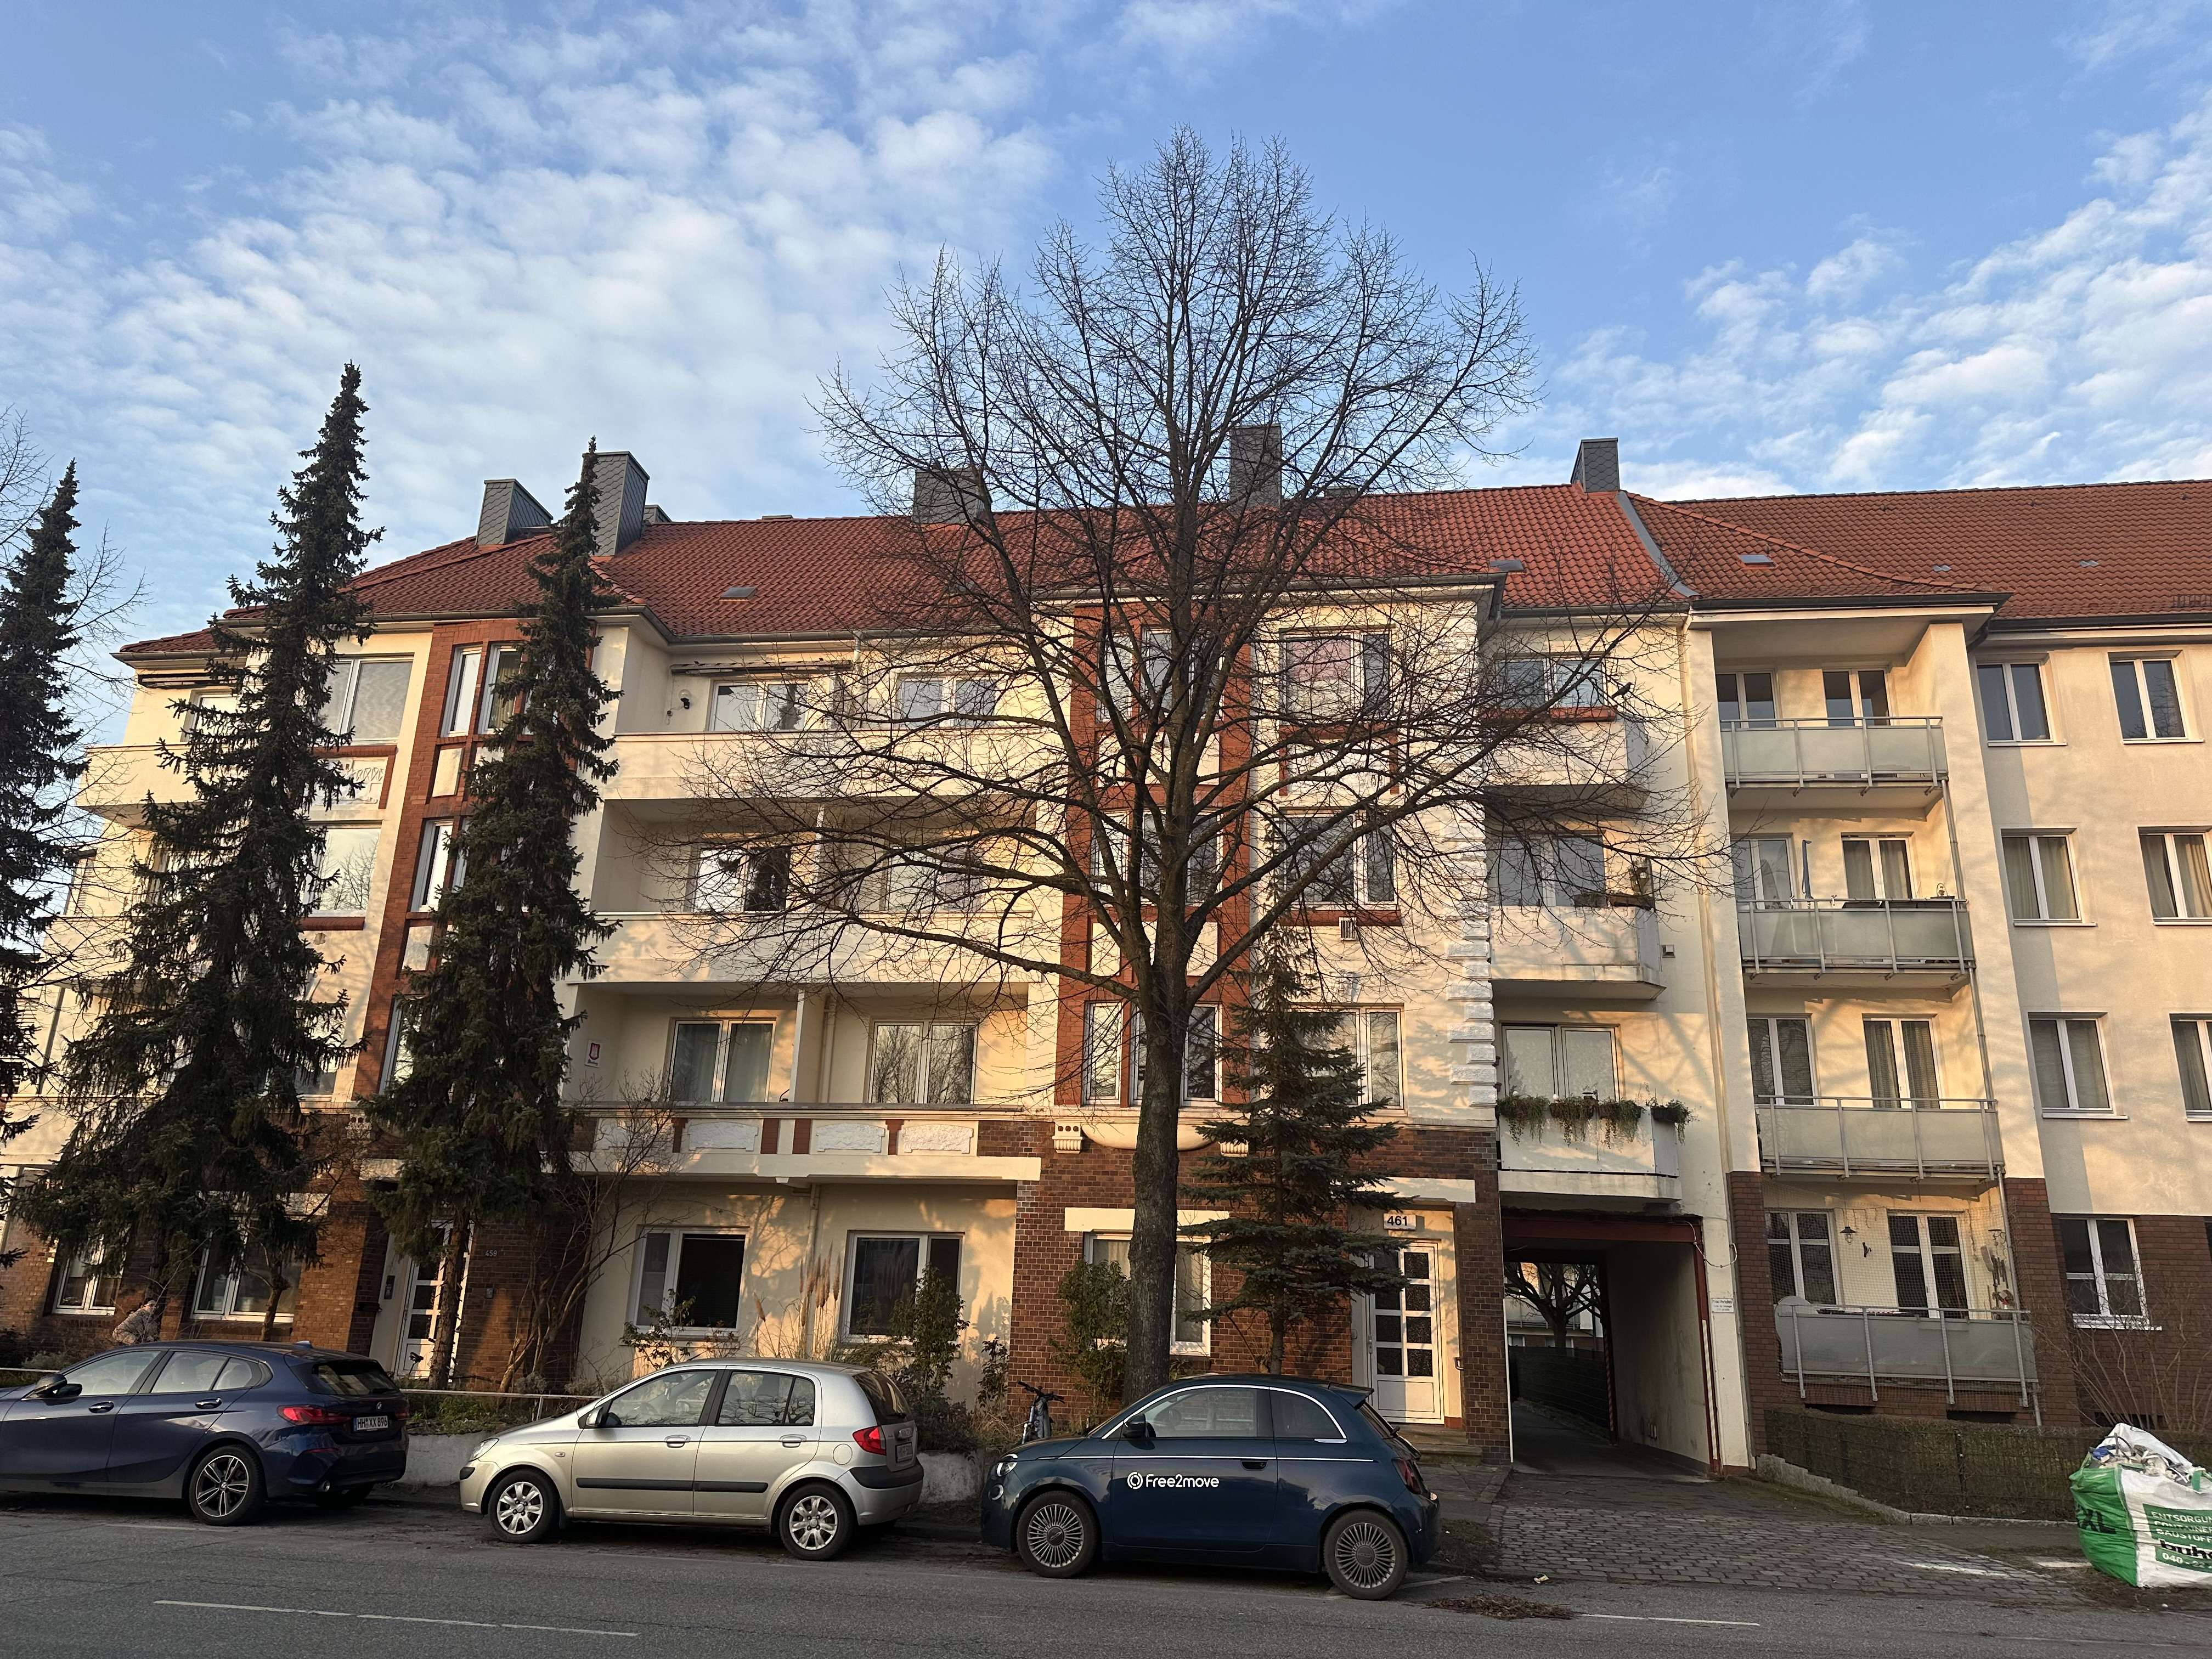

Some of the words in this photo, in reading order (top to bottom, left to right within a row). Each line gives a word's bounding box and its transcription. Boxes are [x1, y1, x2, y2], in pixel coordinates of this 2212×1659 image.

[1387, 1215, 1407, 1226] 461
[357, 1418, 365, 1429] HH
[369, 1417, 376, 1427] XX
[377, 1417, 387, 1427] 896
[1146, 1474, 1220, 1487] Free2move
[2162, 1553, 2183, 1564] 040
